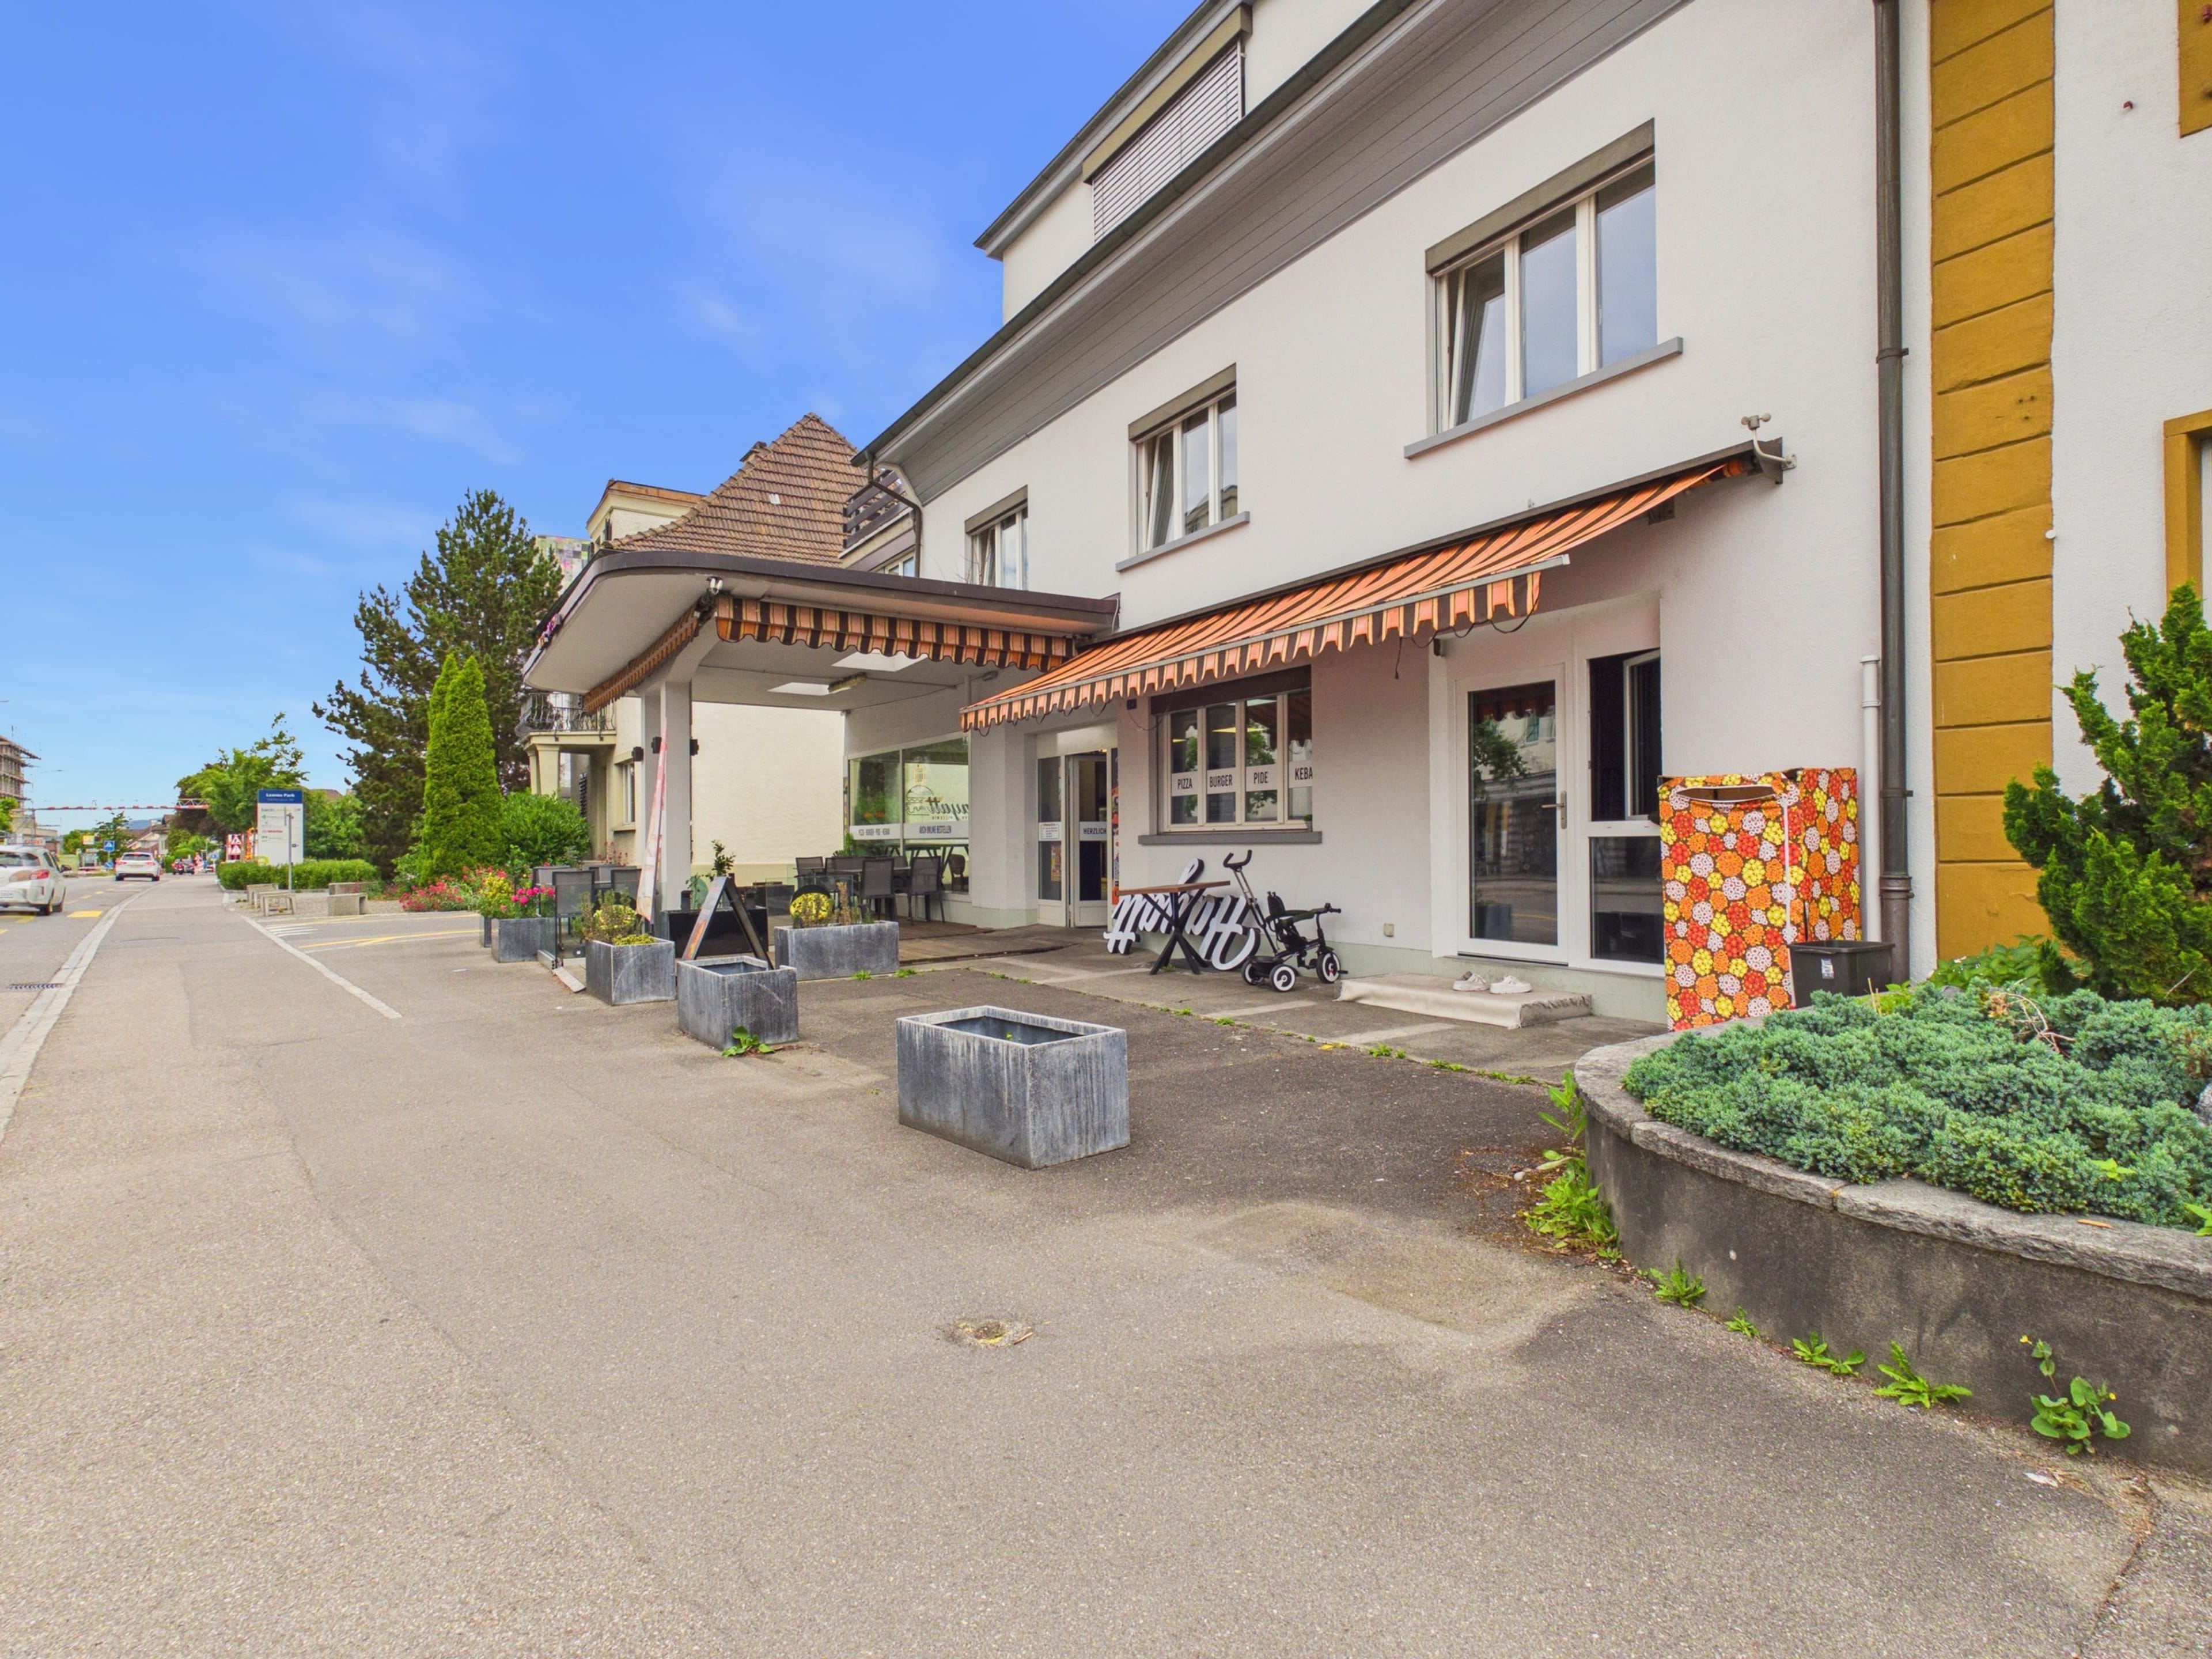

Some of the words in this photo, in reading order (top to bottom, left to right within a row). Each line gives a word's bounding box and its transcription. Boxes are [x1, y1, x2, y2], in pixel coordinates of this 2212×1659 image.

[1177, 778, 1193, 789] PIZZA
[1210, 774, 1233, 787] BURGER
[1253, 771, 1268, 784] PIDE
